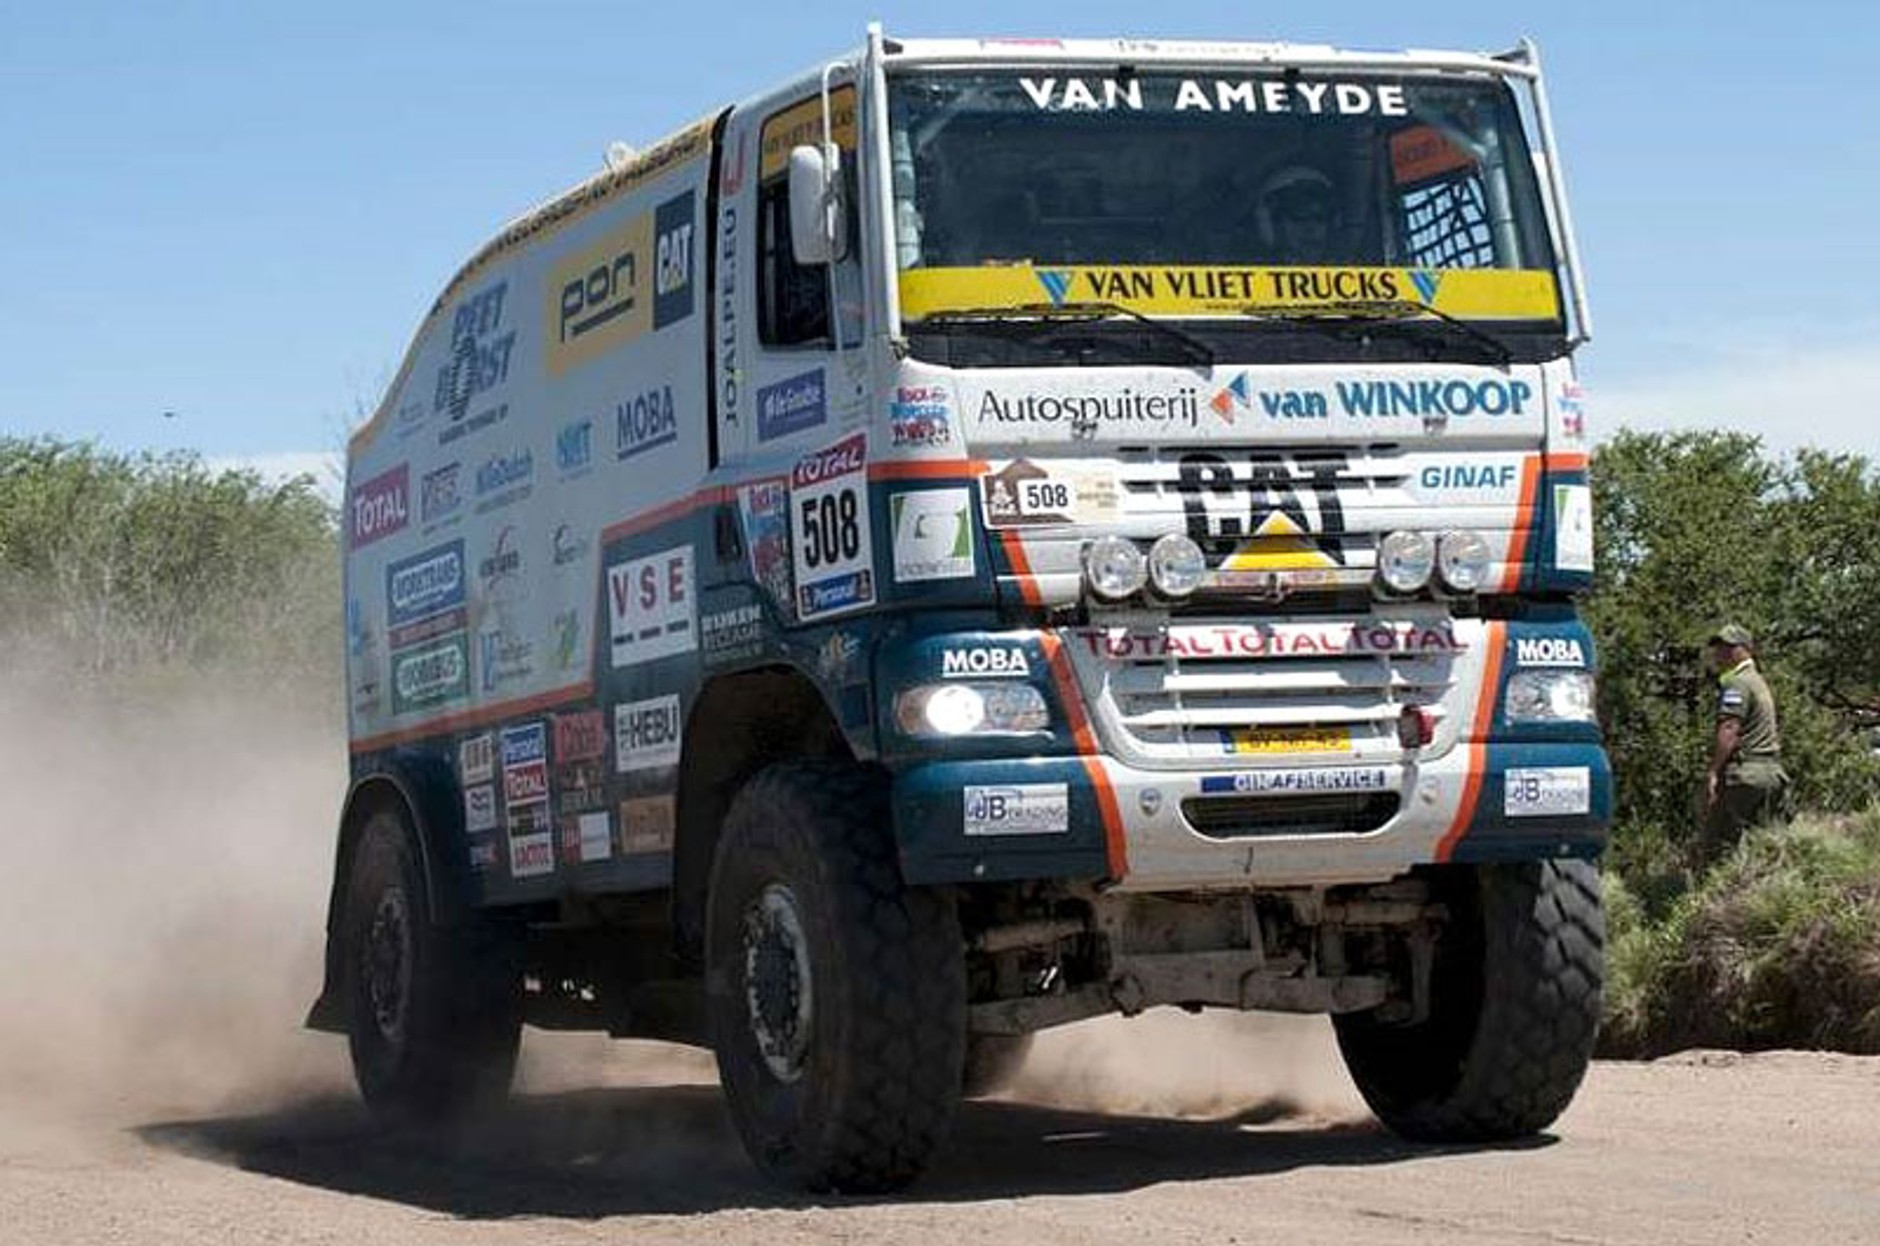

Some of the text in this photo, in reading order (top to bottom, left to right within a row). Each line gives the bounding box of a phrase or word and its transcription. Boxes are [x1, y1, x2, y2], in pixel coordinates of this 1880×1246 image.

[1019, 76, 1408, 117] VAN AMEYDE
[657, 220, 694, 295] CAT
[560, 251, 636, 344] pon
[1086, 270, 1400, 302] VAN VLIET TRUCKS
[617, 385, 677, 449] MOBA
[977, 386, 1198, 425] Autospuiterij
[1259, 390, 1328, 419] van
[1334, 380, 1532, 418] WINKOOP
[797, 446, 862, 483] TOTAL
[1420, 465, 1517, 490] GINAF
[354, 487, 407, 538] TOTAL
[1027, 484, 1068, 510] 508
[1178, 453, 1350, 570] CAT
[802, 489, 860, 568] 508
[942, 648, 1027, 672] MOBA
[1077, 624, 1469, 657] TOTAL TOTAL TOTAL
[1517, 638, 1583, 662] MOBA
[630, 703, 678, 749] HEBU
